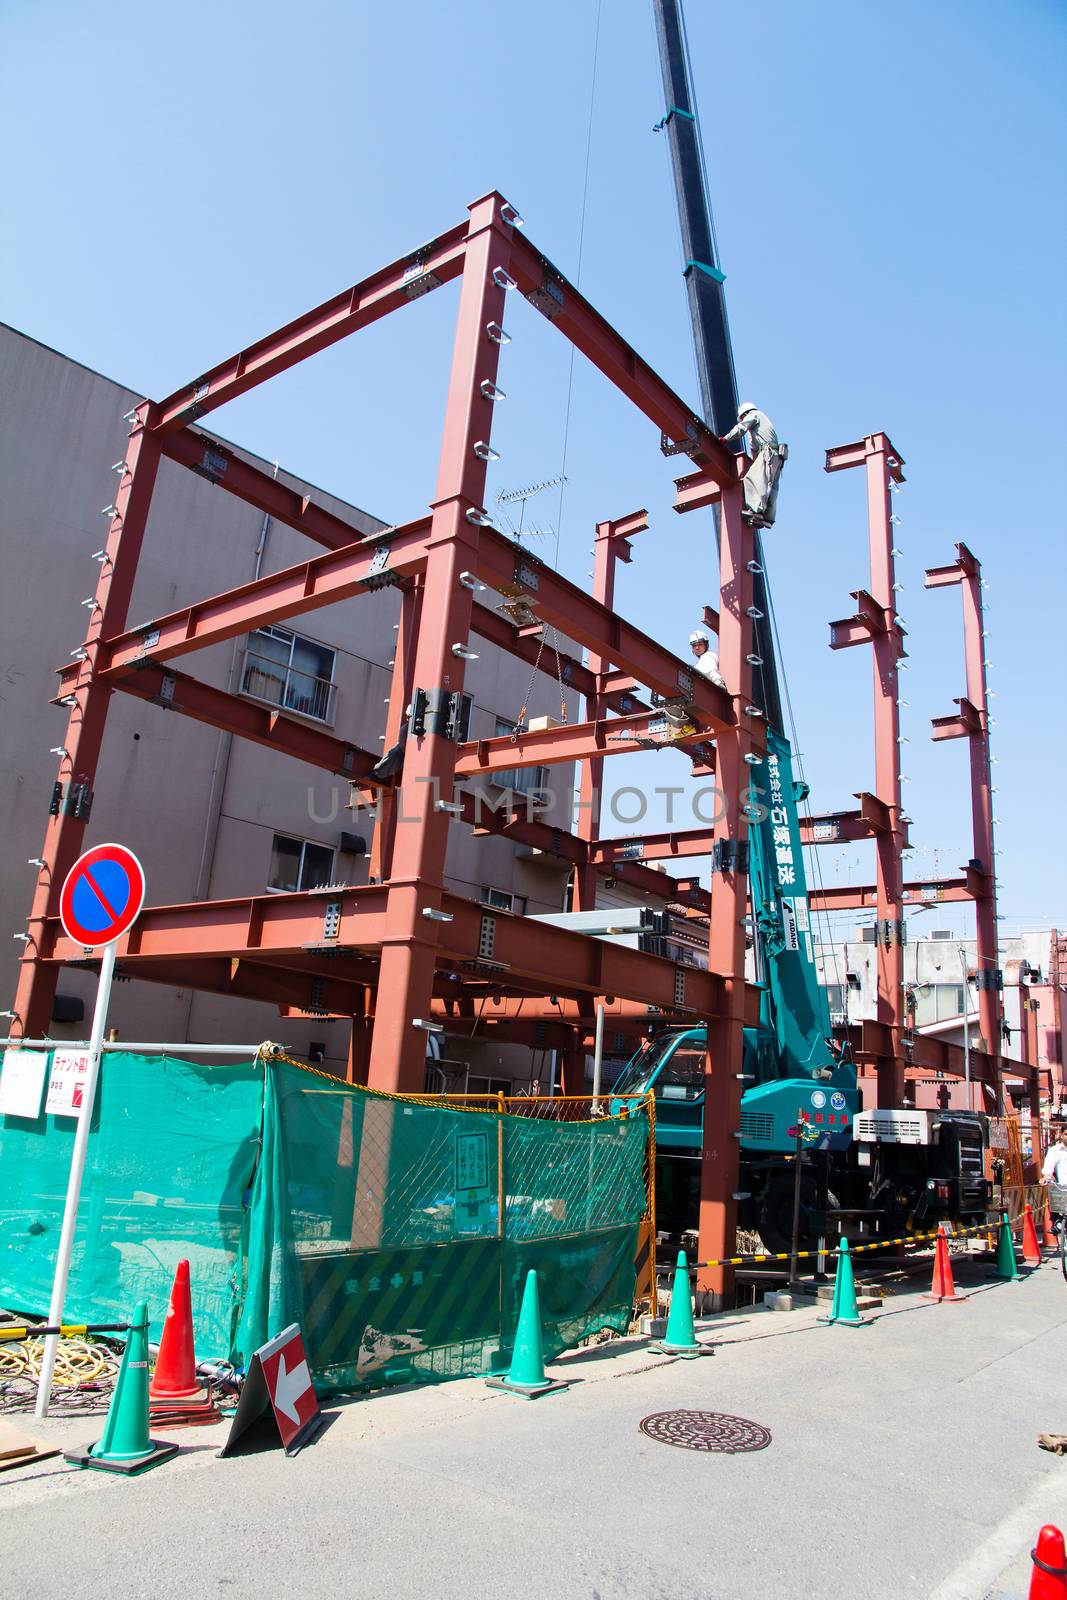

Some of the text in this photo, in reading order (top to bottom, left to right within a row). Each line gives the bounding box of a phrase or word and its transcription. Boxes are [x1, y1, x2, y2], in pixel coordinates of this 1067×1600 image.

[788, 917, 798, 949] TADANO
[54, 1056, 89, 1073] テナント募
